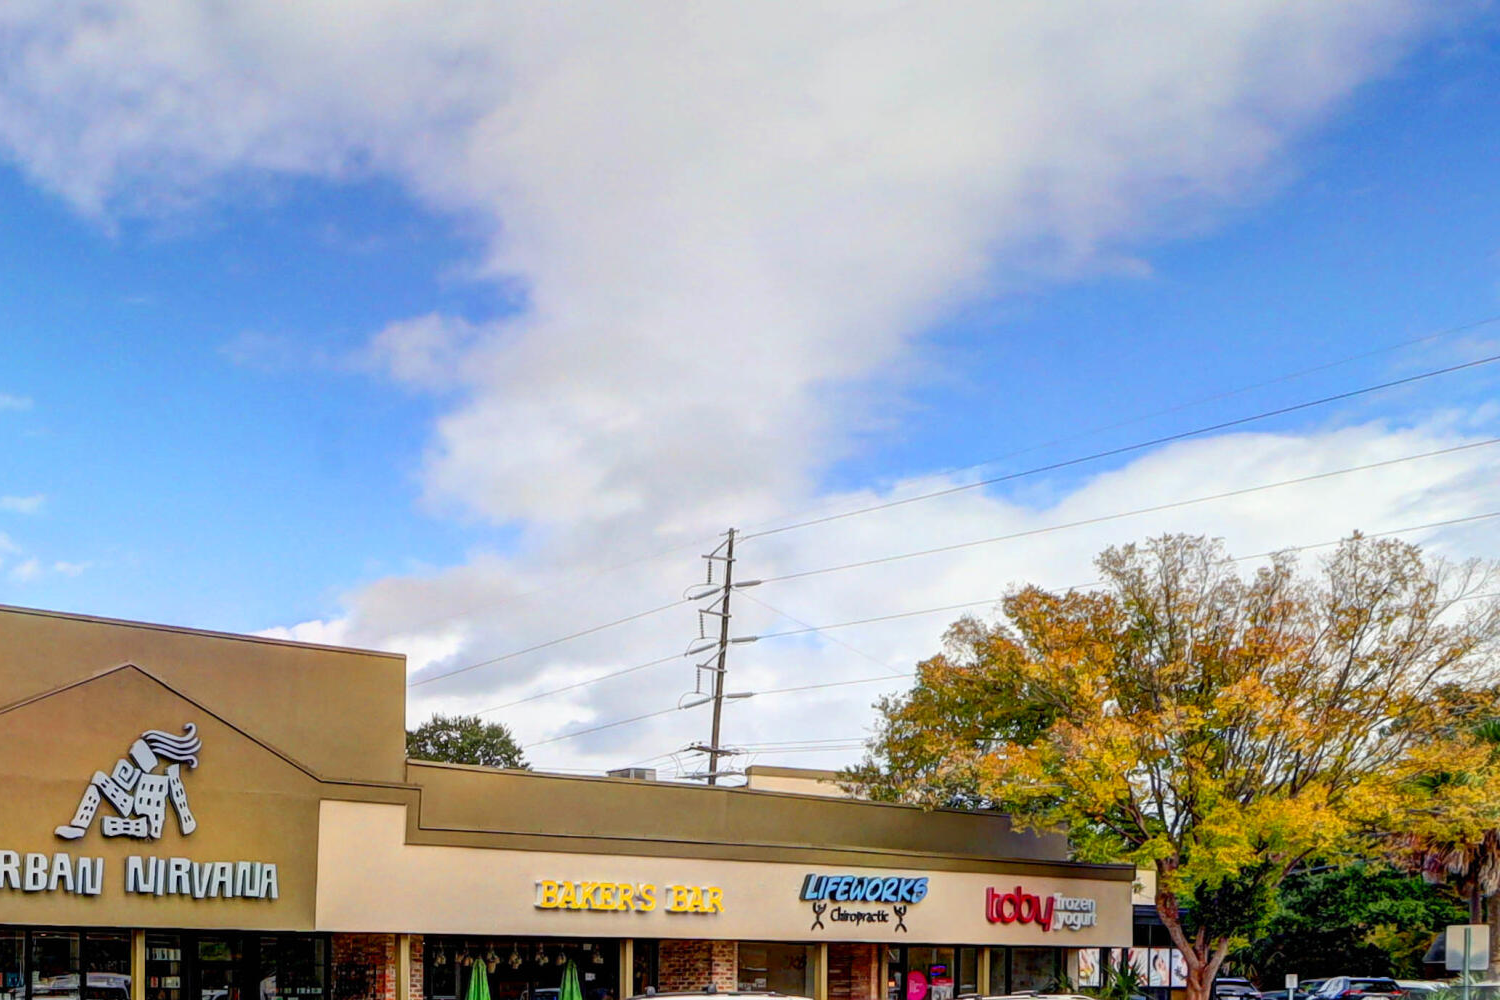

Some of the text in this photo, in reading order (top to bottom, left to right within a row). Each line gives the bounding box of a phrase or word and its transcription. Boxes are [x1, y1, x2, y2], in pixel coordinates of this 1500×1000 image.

[125, 855, 278, 899] NIRVANA
[799, 873, 929, 904] LIFEWORKS
[534, 879, 725, 913] BAKER'S BAR
[1053, 892, 1096, 911] frozen
[830, 906, 889, 926] Chiropractic
[1053, 912, 1098, 931] yogurt
